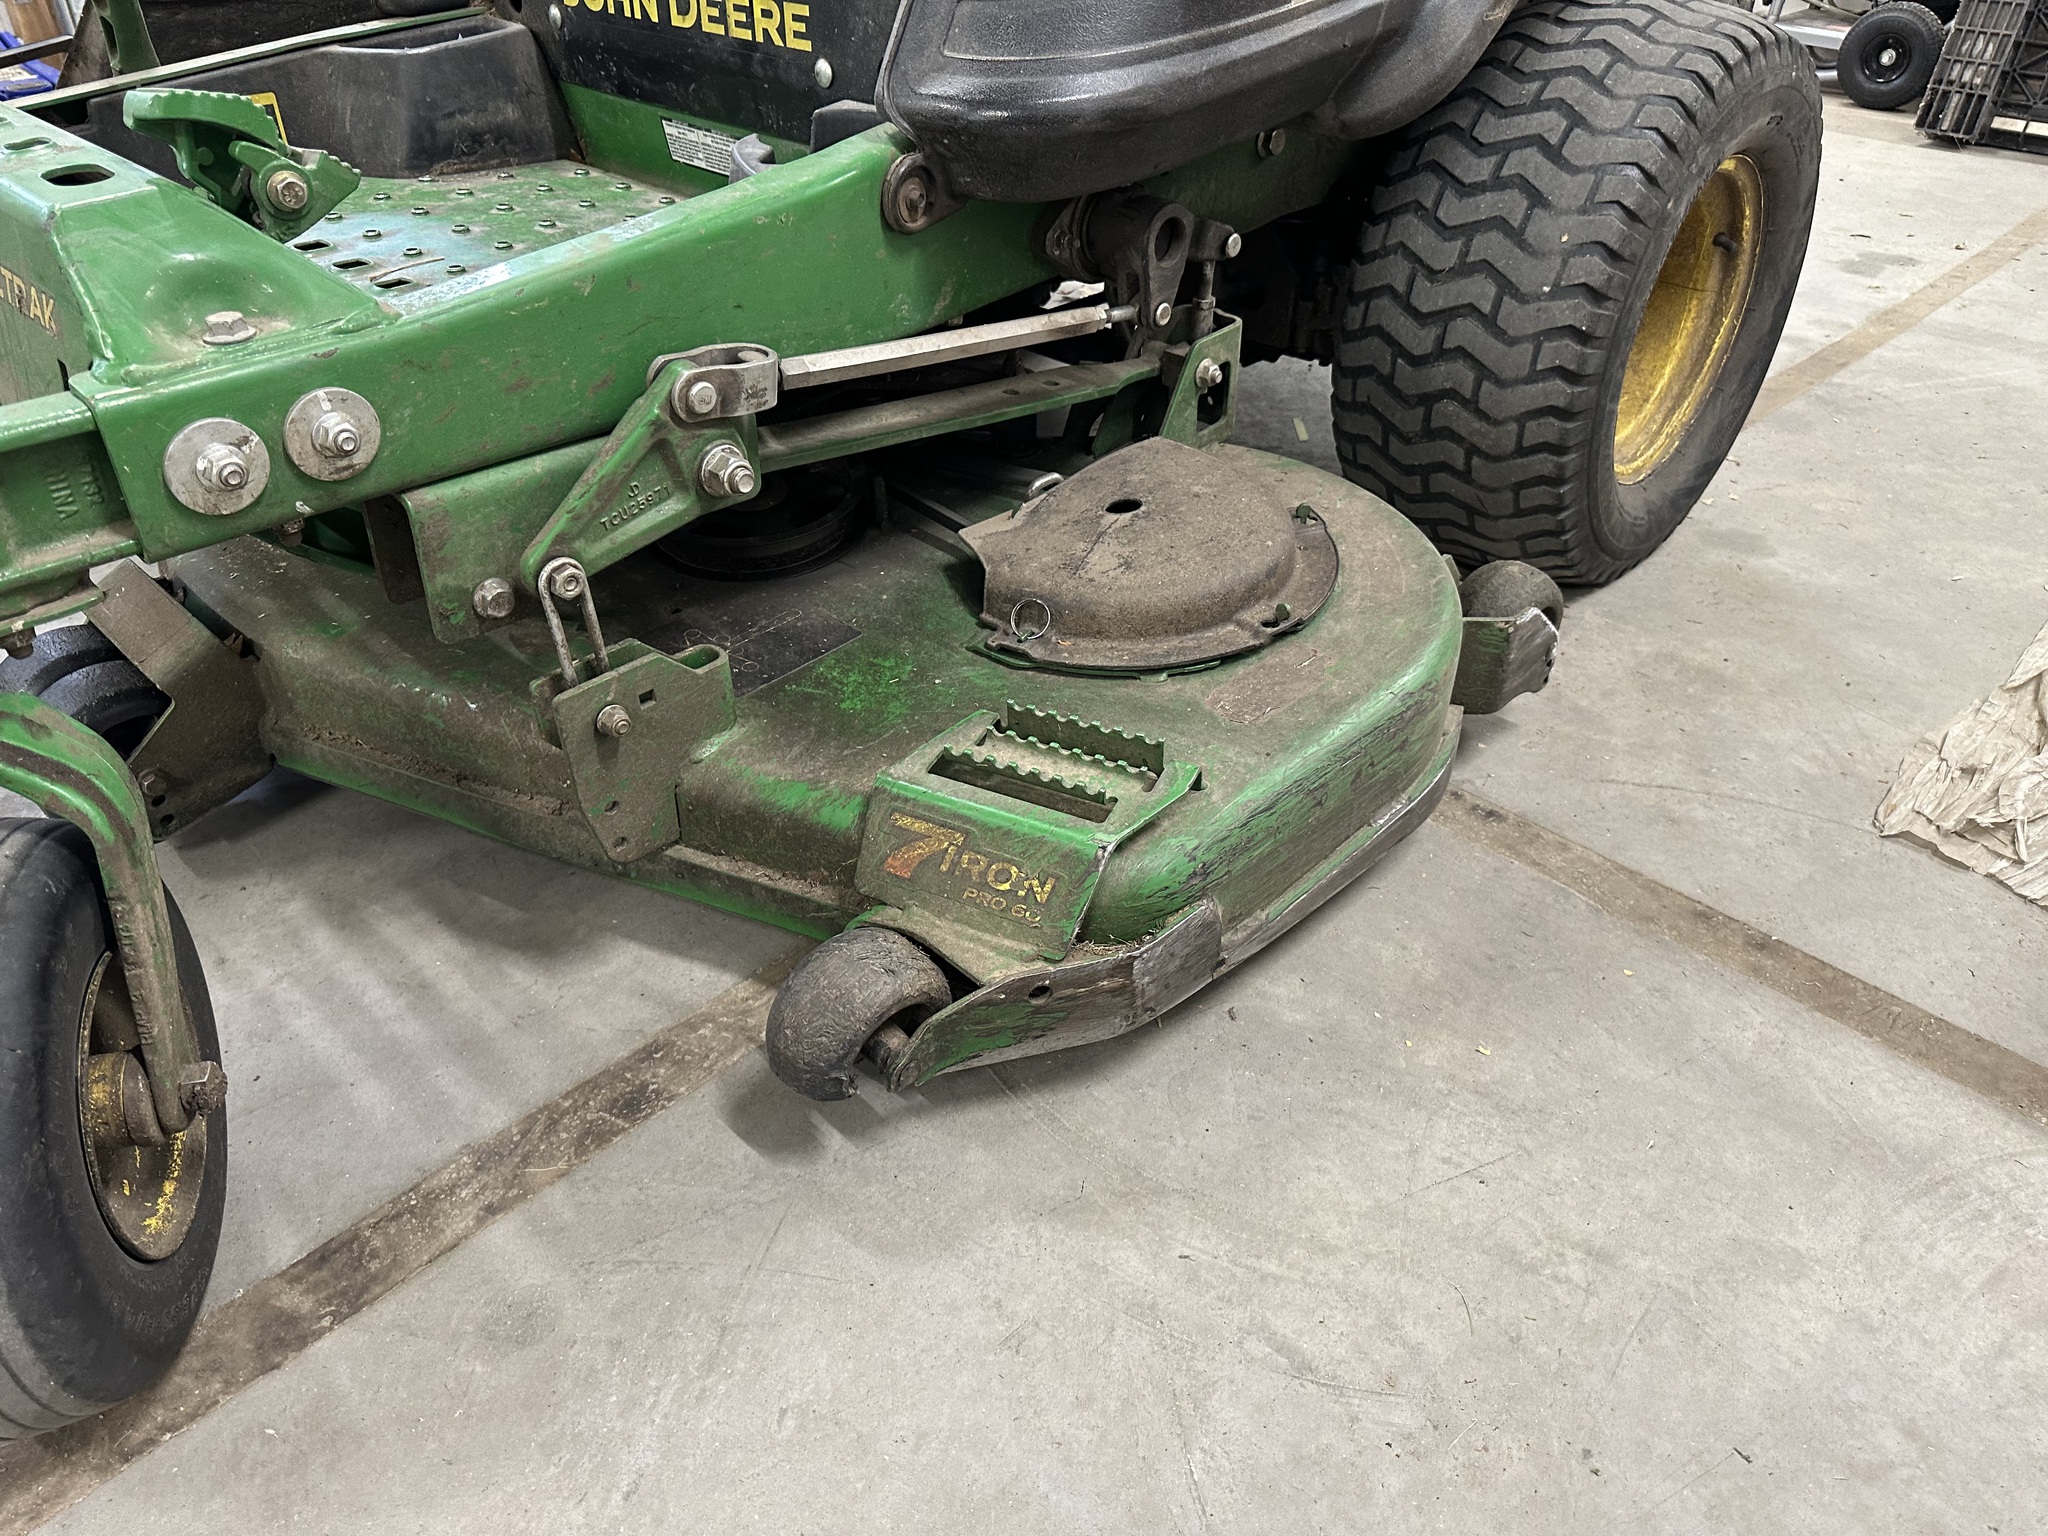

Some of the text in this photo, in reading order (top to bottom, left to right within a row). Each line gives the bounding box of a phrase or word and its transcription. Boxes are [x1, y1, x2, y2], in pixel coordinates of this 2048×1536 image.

[563, 0, 812, 52] HN DEERE
[0, 265, 59, 340] TRAK
[962, 887, 1007, 911] PRO
